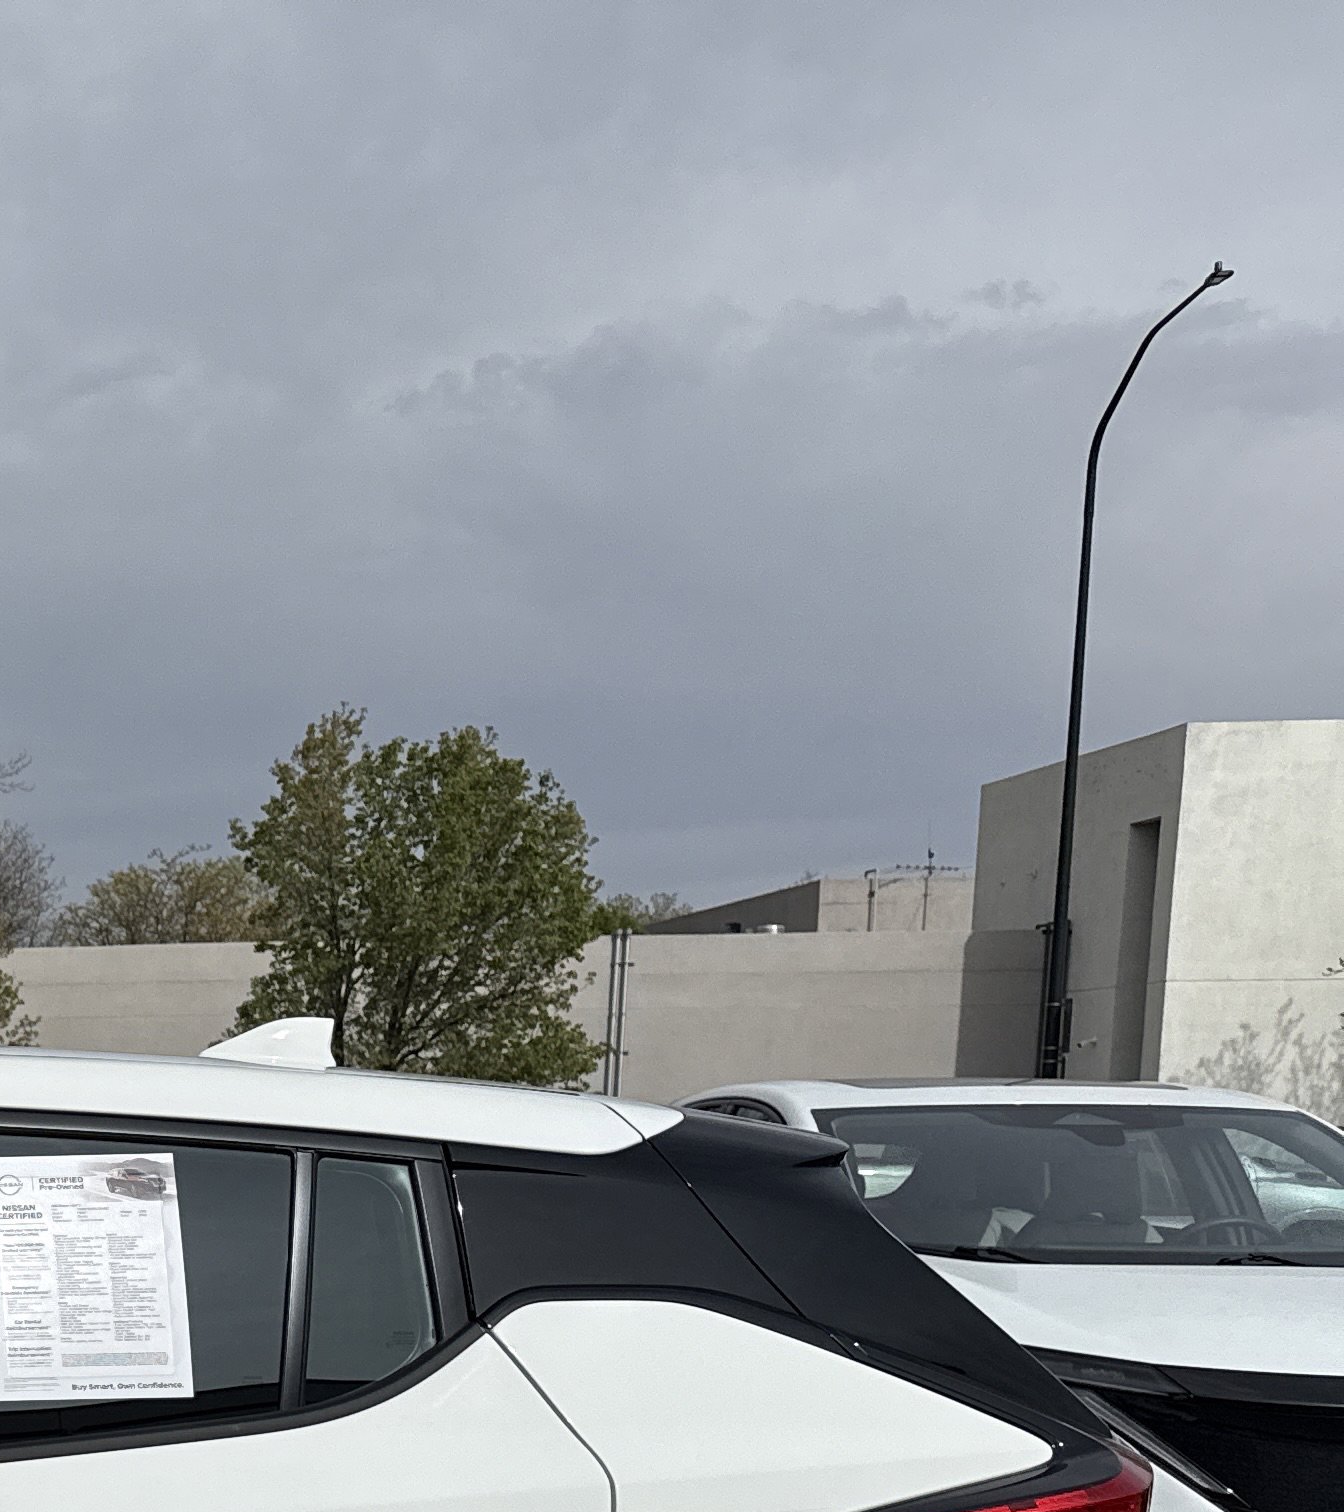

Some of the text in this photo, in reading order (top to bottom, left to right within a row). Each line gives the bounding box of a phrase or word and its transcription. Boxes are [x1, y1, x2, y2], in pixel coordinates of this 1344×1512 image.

[38, 1176, 84, 1184] CERTIFIED
[39, 1183, 85, 1191] Pre-Owned
[2, 1204, 36, 1212] NISSAN
